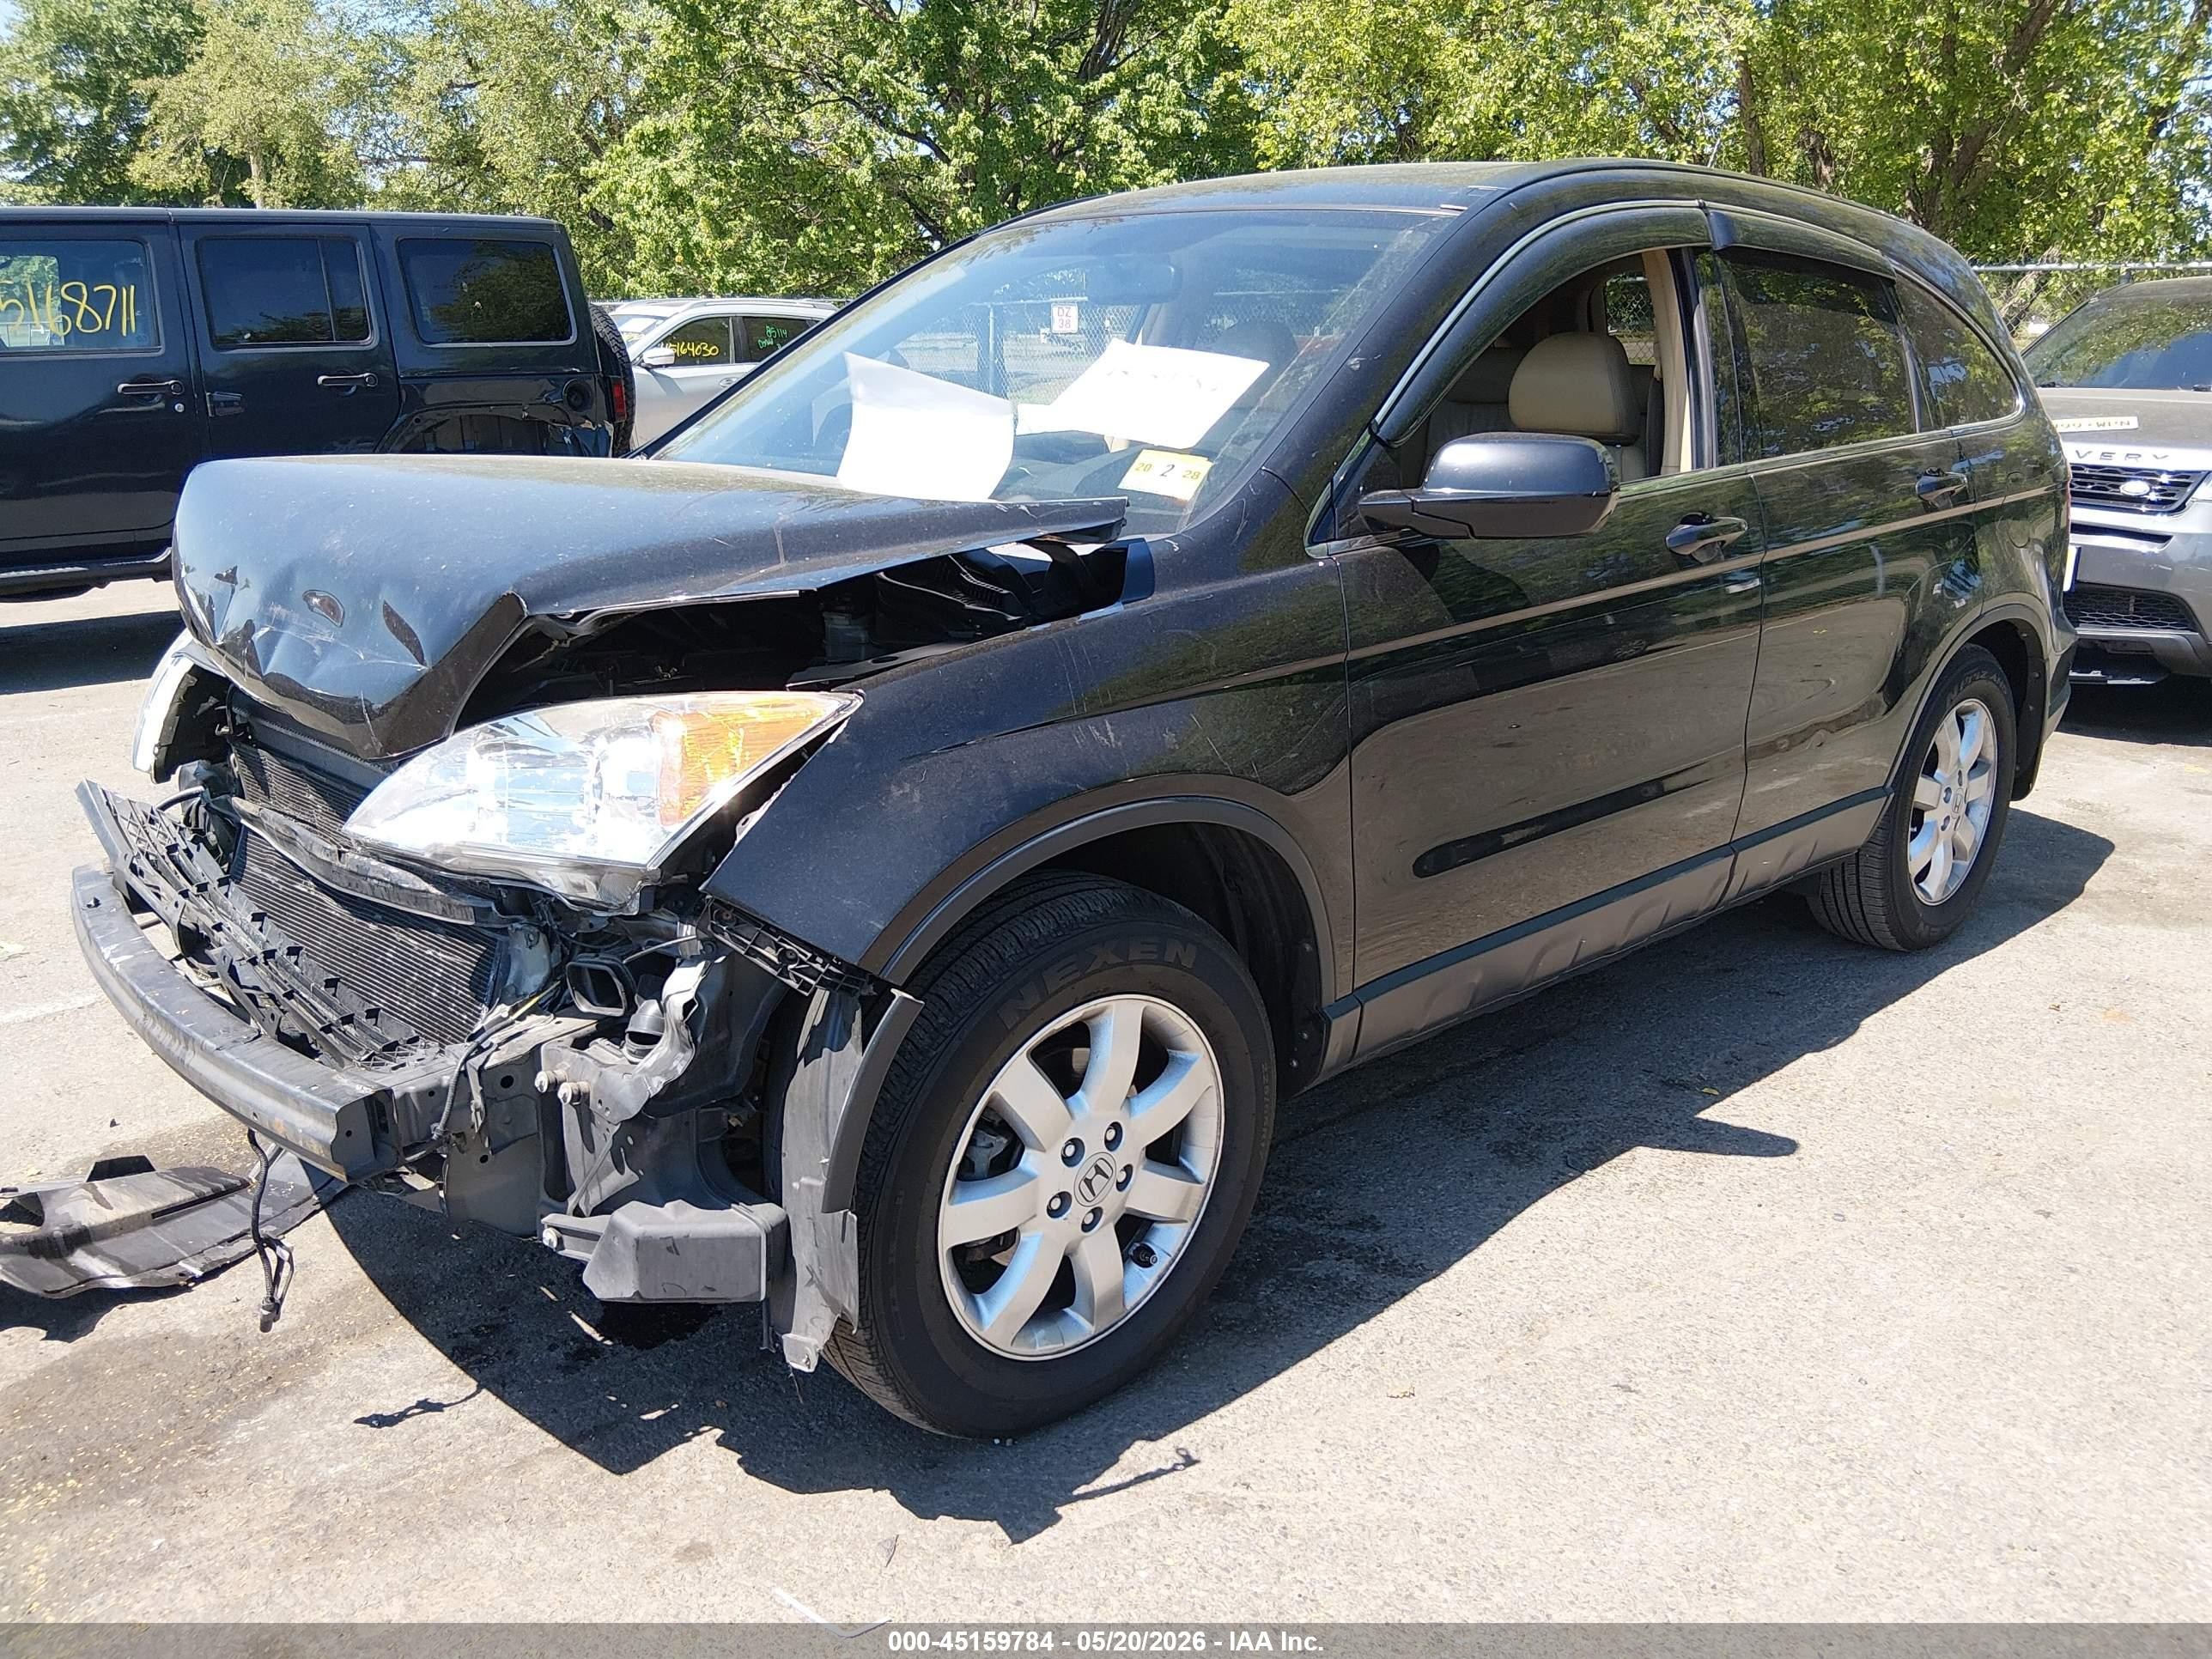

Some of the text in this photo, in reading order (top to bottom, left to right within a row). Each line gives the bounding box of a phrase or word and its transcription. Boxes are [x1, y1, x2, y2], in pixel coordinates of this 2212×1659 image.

[1058, 319, 1071, 328] 38
[1135, 462, 1201, 480] 20 2 28
[997, 939, 1197, 1030] NEXEN
